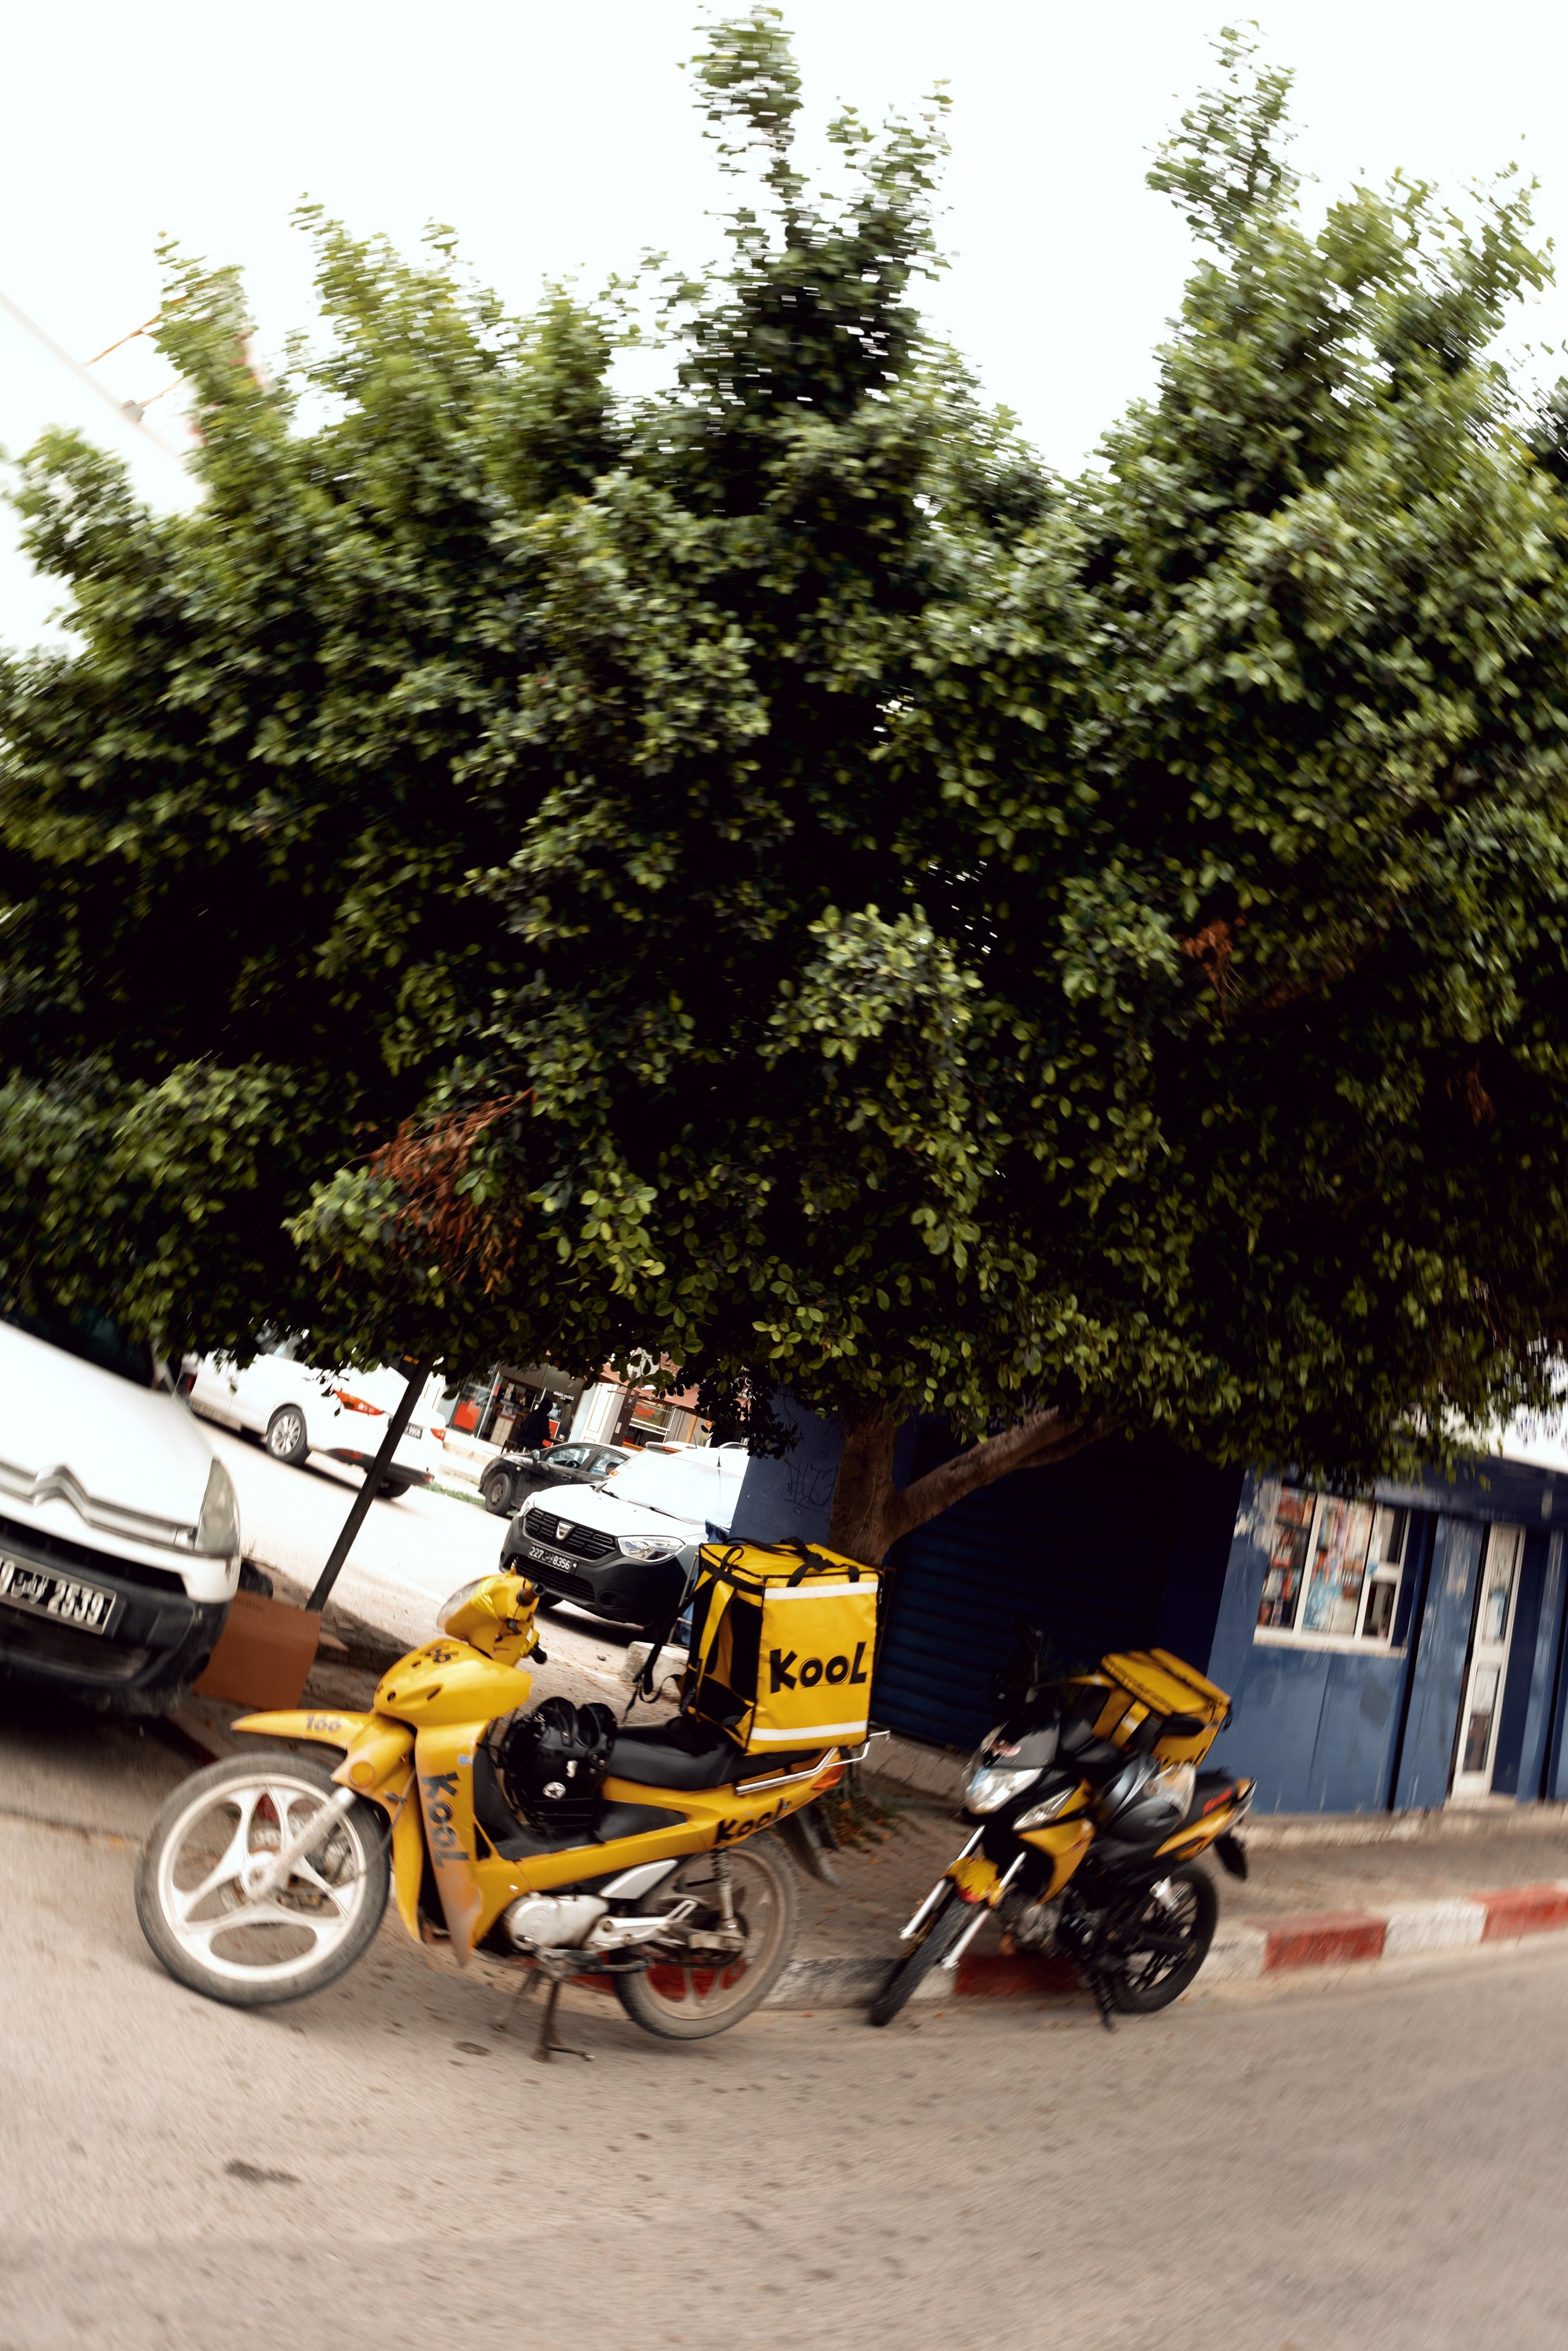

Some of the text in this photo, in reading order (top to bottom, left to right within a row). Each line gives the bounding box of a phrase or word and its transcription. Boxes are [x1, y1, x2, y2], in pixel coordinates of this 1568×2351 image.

[528, 1546, 544, 1560] 227
[552, 1555, 572, 1570] 8356
[47, 1579, 105, 1627] 2539
